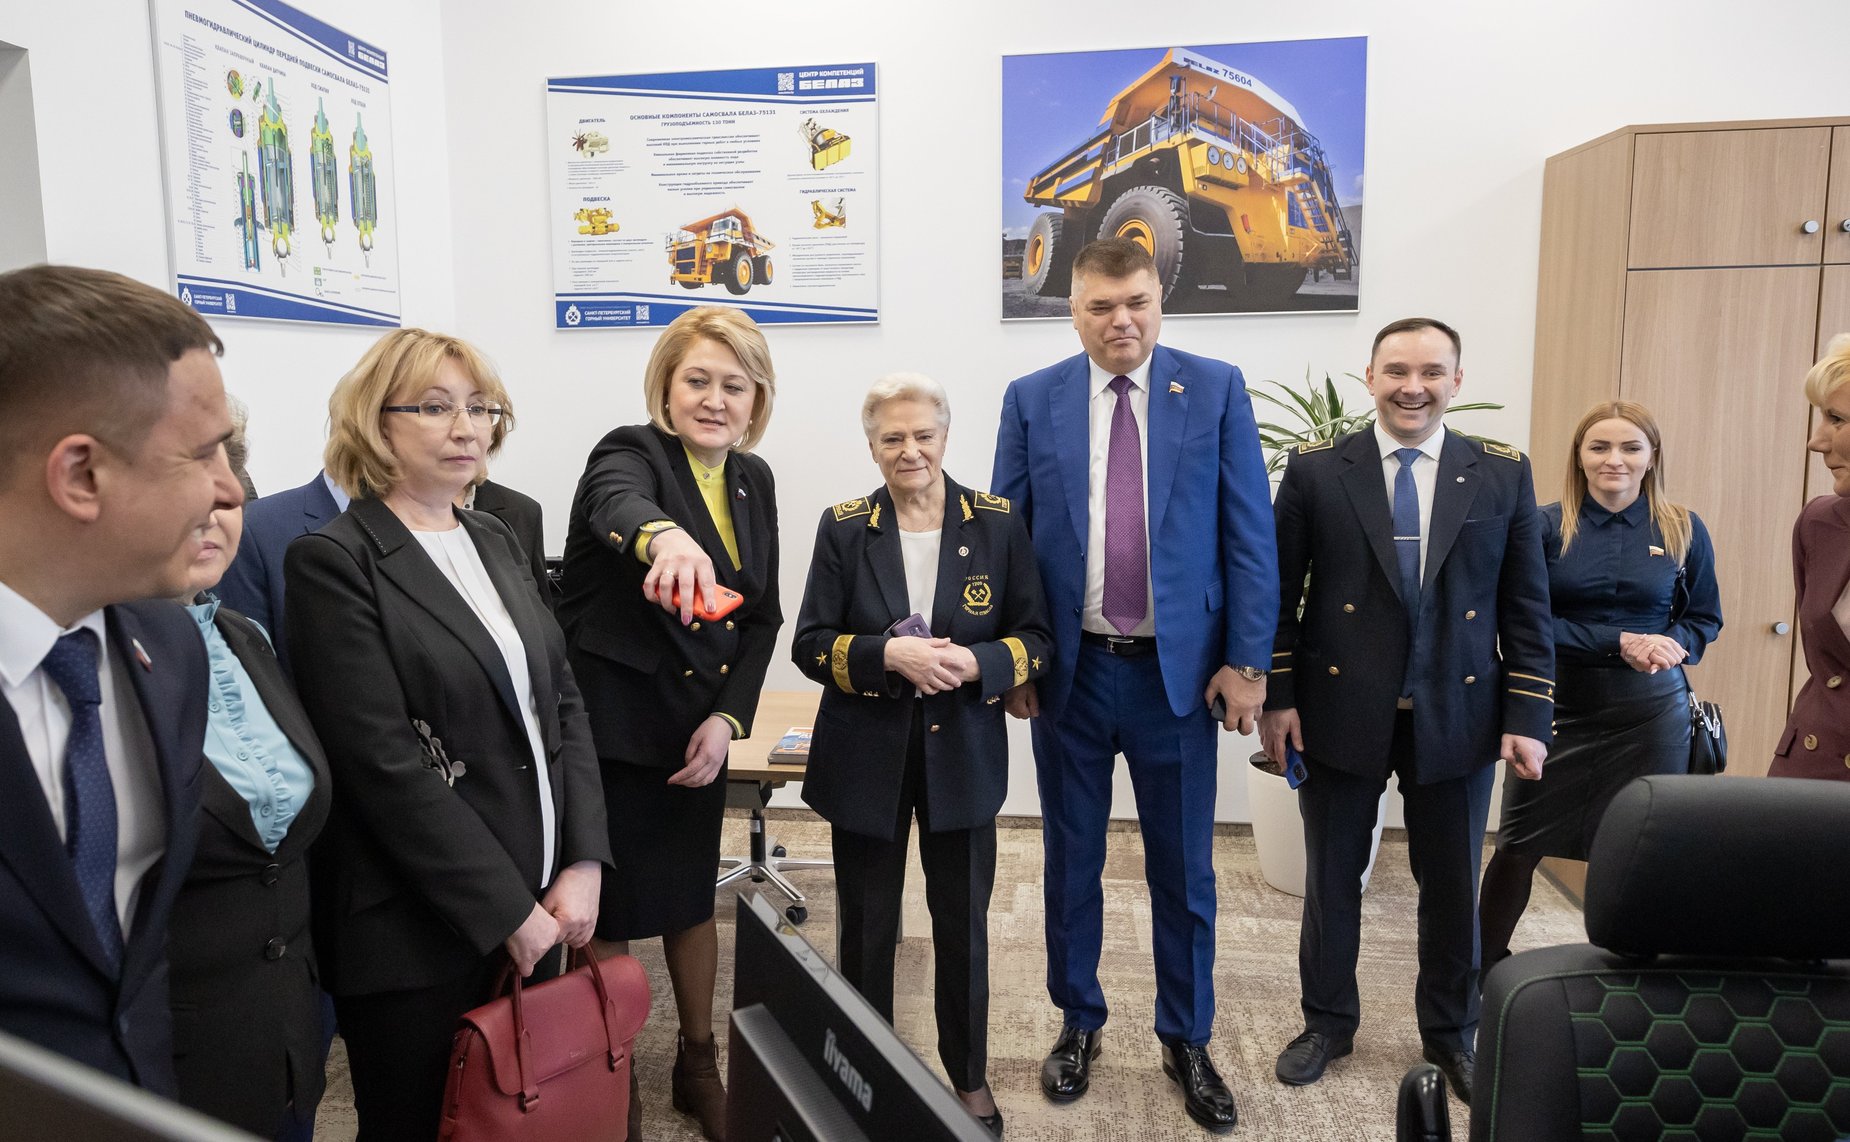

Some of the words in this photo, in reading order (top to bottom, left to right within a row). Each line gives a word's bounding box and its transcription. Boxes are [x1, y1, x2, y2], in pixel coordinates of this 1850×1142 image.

[185, 10, 252, 45] ПНЕВМОГИДРАВЛИЧЕСКИЙ
[253, 40, 275, 55] ЦИЛИНДР
[276, 49, 298, 64] ПЕРЕДНЕЙ
[299, 59, 321, 73] ПОДВЕСКИ
[322, 68, 345, 84] САМОСВАЛА
[819, 68, 864, 76] КОМПЕТЕНЦИЙ
[1222, 69, 1252, 87] 75604
[799, 78, 864, 90] БЕЛАЗ
